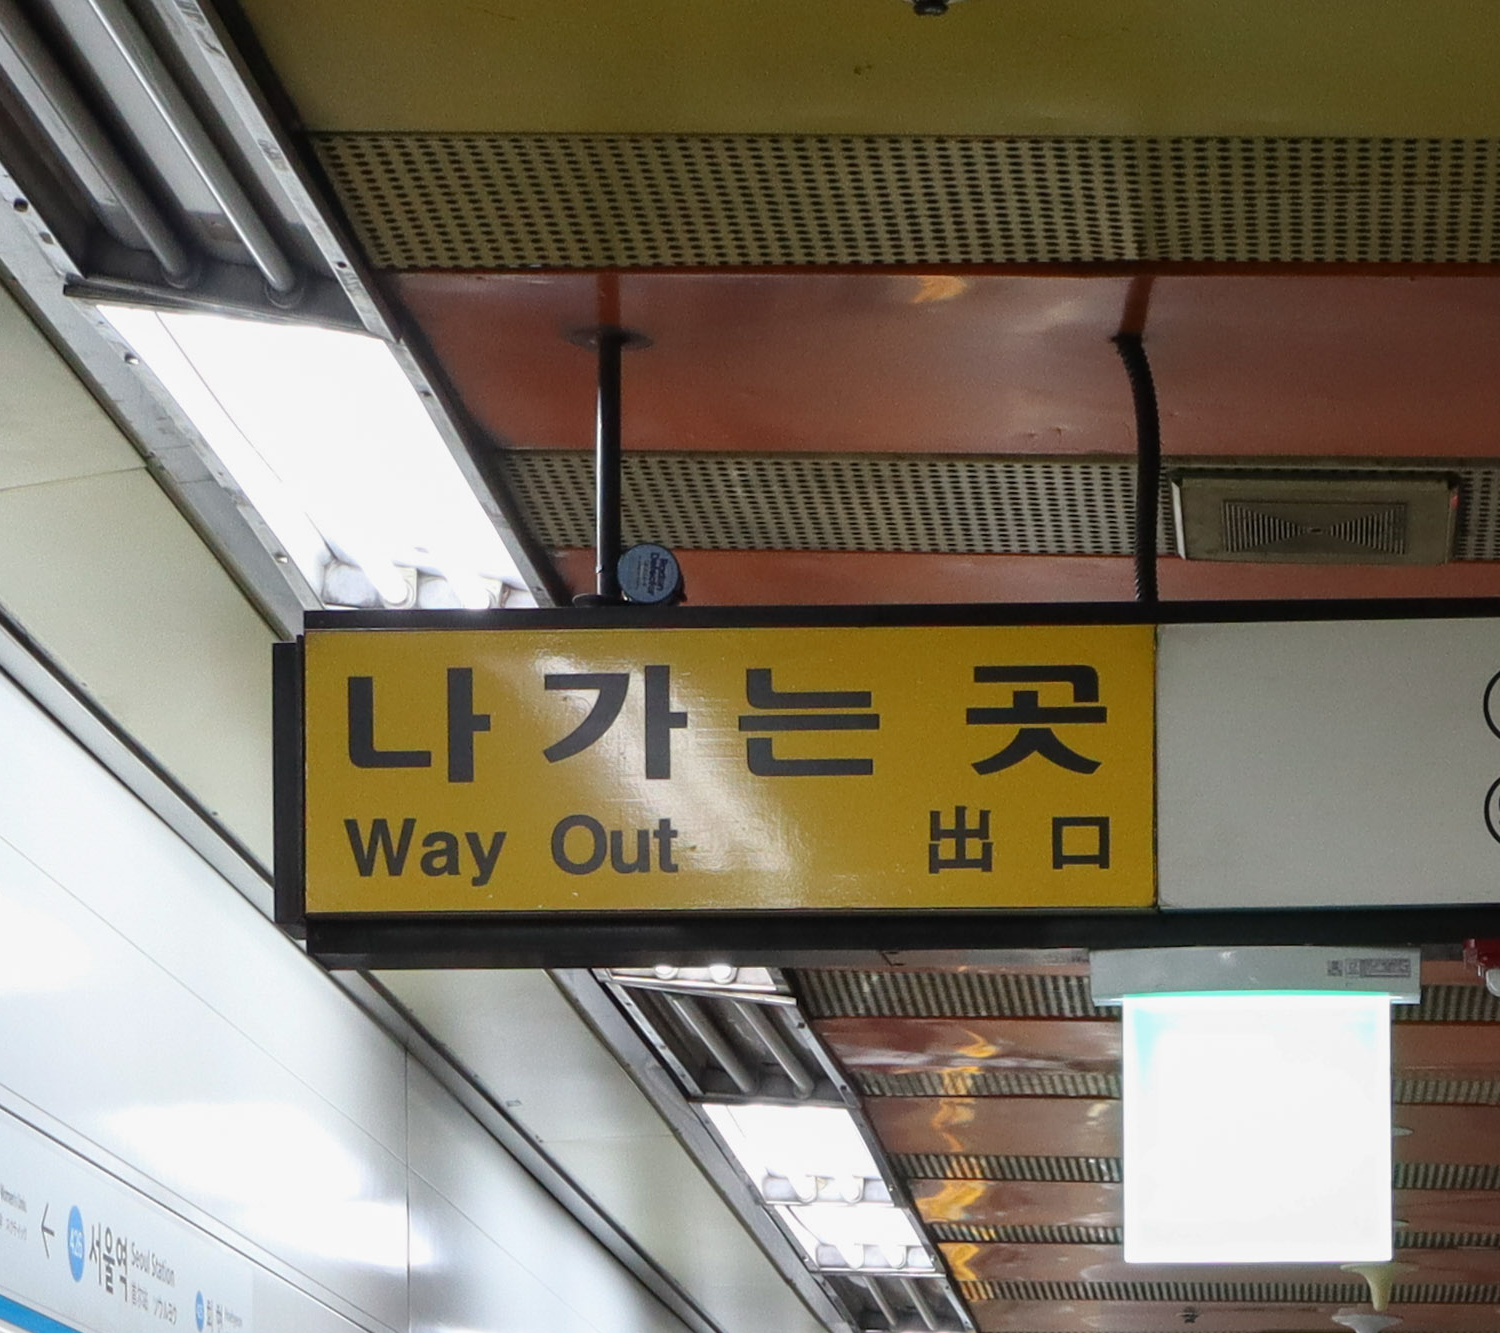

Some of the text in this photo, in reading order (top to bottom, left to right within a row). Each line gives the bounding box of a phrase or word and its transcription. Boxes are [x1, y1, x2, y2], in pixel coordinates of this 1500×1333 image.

[964, 664, 1108, 776] 곳
[346, 814, 680, 887] Way Out
[89, 1222, 128, 1303] 서울역
[131, 1240, 176, 1288] Seoul Station
